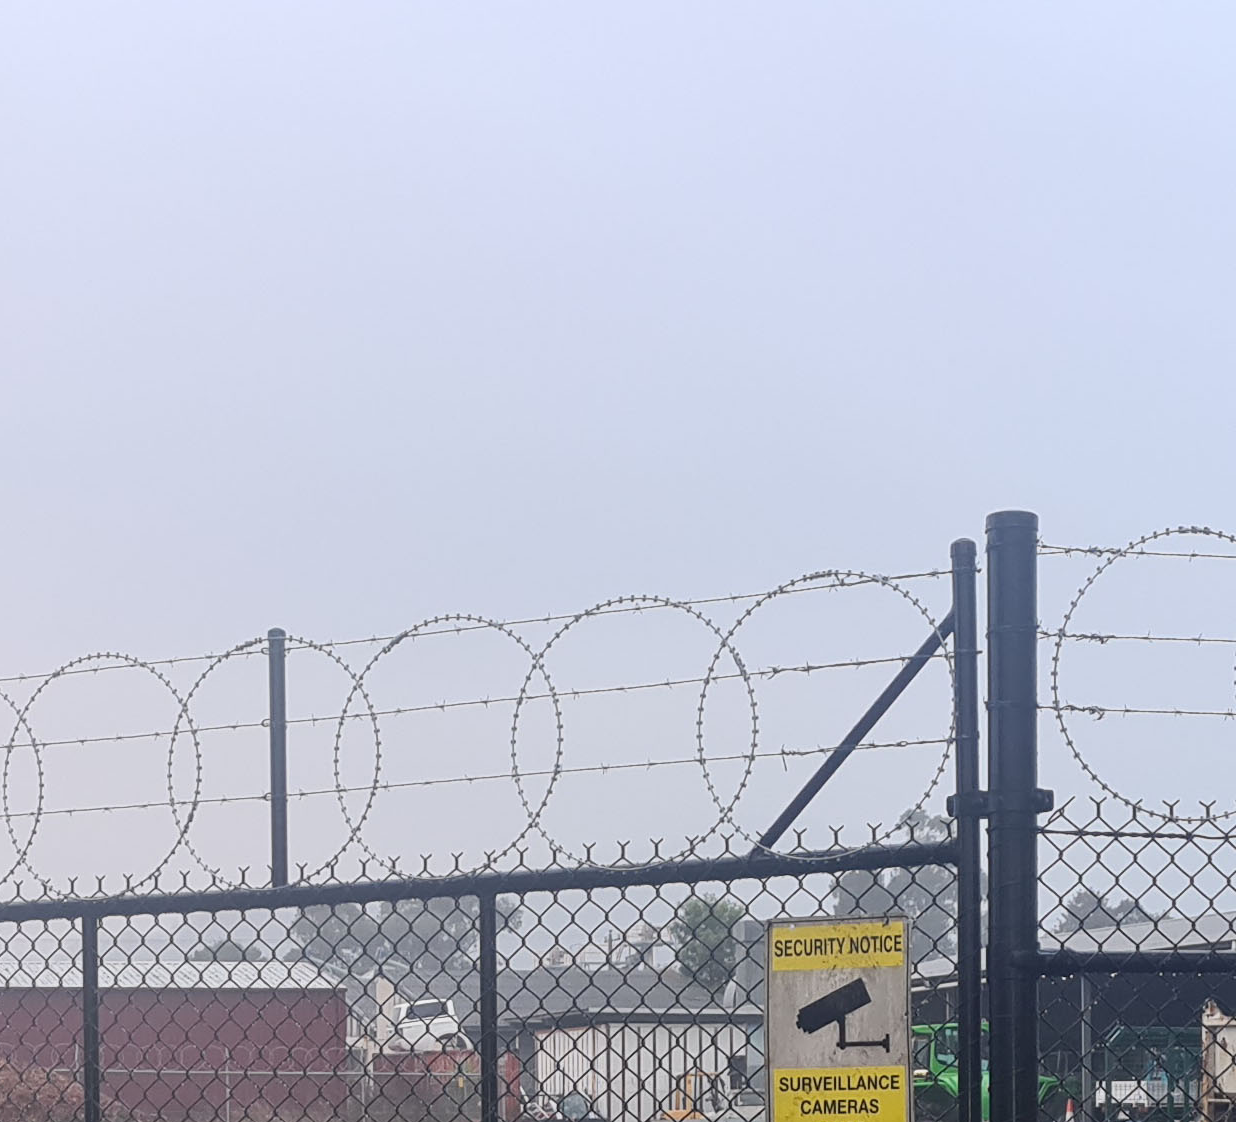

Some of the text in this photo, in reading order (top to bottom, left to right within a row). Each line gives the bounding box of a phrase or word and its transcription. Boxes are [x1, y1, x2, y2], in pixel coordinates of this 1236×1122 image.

[774, 934, 903, 958] SECURITY NOTICE
[779, 1074, 900, 1093] SURVEILLANCE
[800, 1098, 879, 1116] CAMERAS
